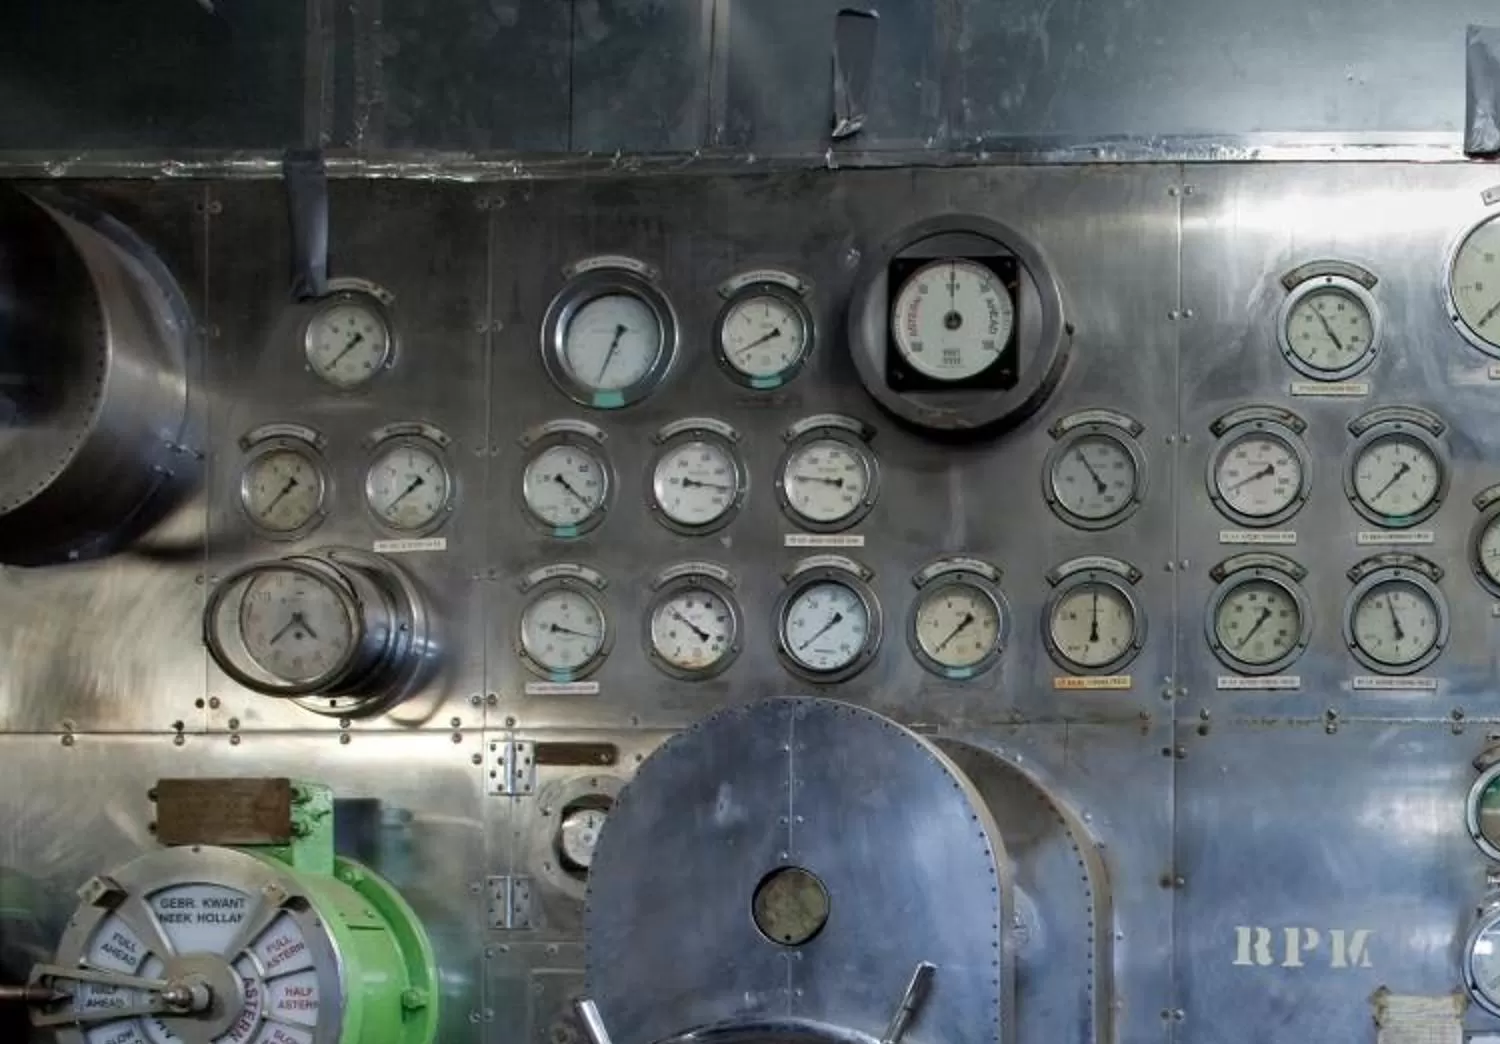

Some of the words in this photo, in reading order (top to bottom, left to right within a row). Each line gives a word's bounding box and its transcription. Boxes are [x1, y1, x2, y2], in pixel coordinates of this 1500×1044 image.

[202, 897, 244, 909] KWANT
[159, 913, 193, 924] NEEK
[112, 932, 137, 951] FULL
[266, 936, 293, 953] FULL
[1232, 926, 1377, 968] RPM
[101, 943, 137, 967] AHEAD
[267, 943, 306, 969] ASTERN
[284, 987, 314, 996] HALF
[86, 996, 125, 1008] AHEAD
[229, 977, 260, 1043] ASTERN
